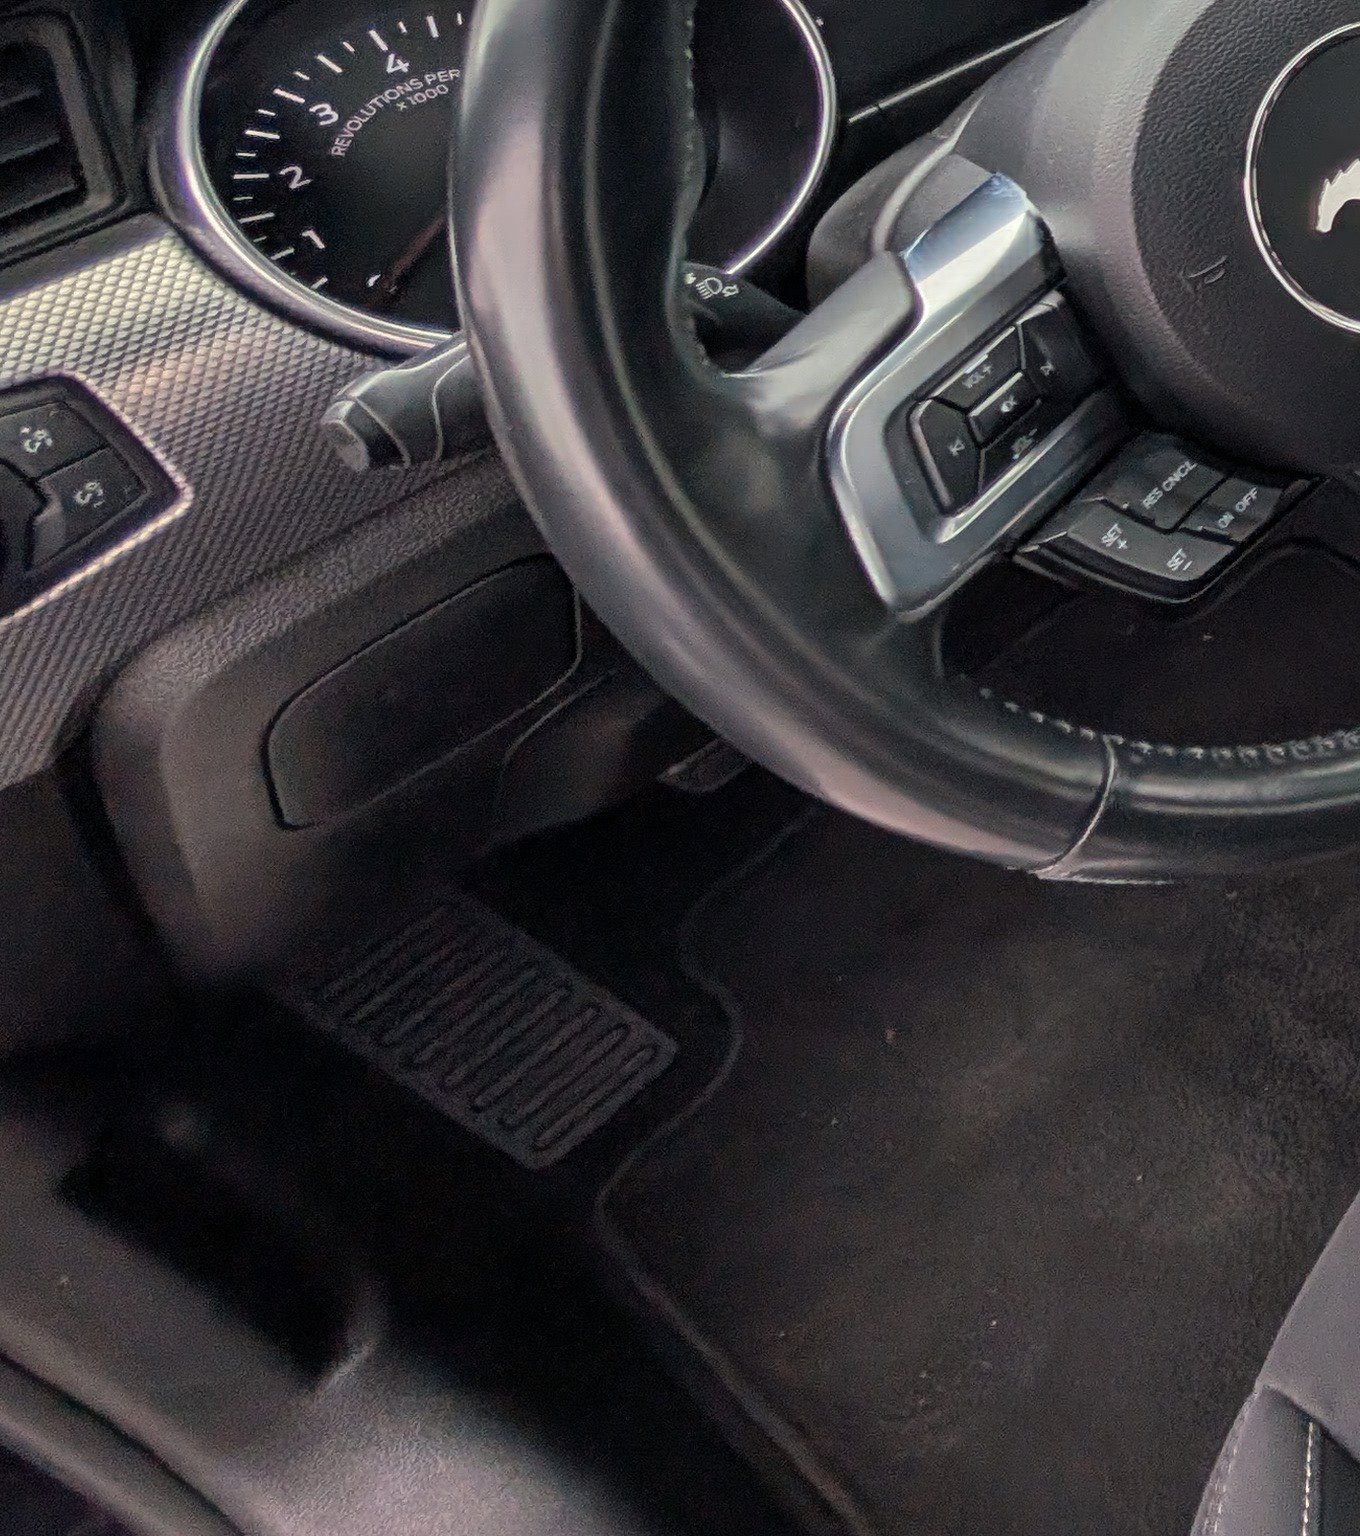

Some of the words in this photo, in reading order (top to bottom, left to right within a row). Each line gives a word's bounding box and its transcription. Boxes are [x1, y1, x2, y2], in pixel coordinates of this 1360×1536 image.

[386, 53, 410, 73] 4
[406, 83, 450, 107] 1000
[308, 102, 340, 126] 3
[330, 77, 424, 158] REVOLUTIONS
[423, 67, 461, 86] PER
[278, 164, 314, 191] 2
[301, 229, 326, 250] 1
[1142, 487, 1164, 510] RES
[1161, 460, 1198, 492] CNCL
[1217, 510, 1235, 529] ON
[1235, 486, 1259, 513] OFF
[1101, 522, 1123, 548] SET
[1166, 547, 1188, 572] SET
